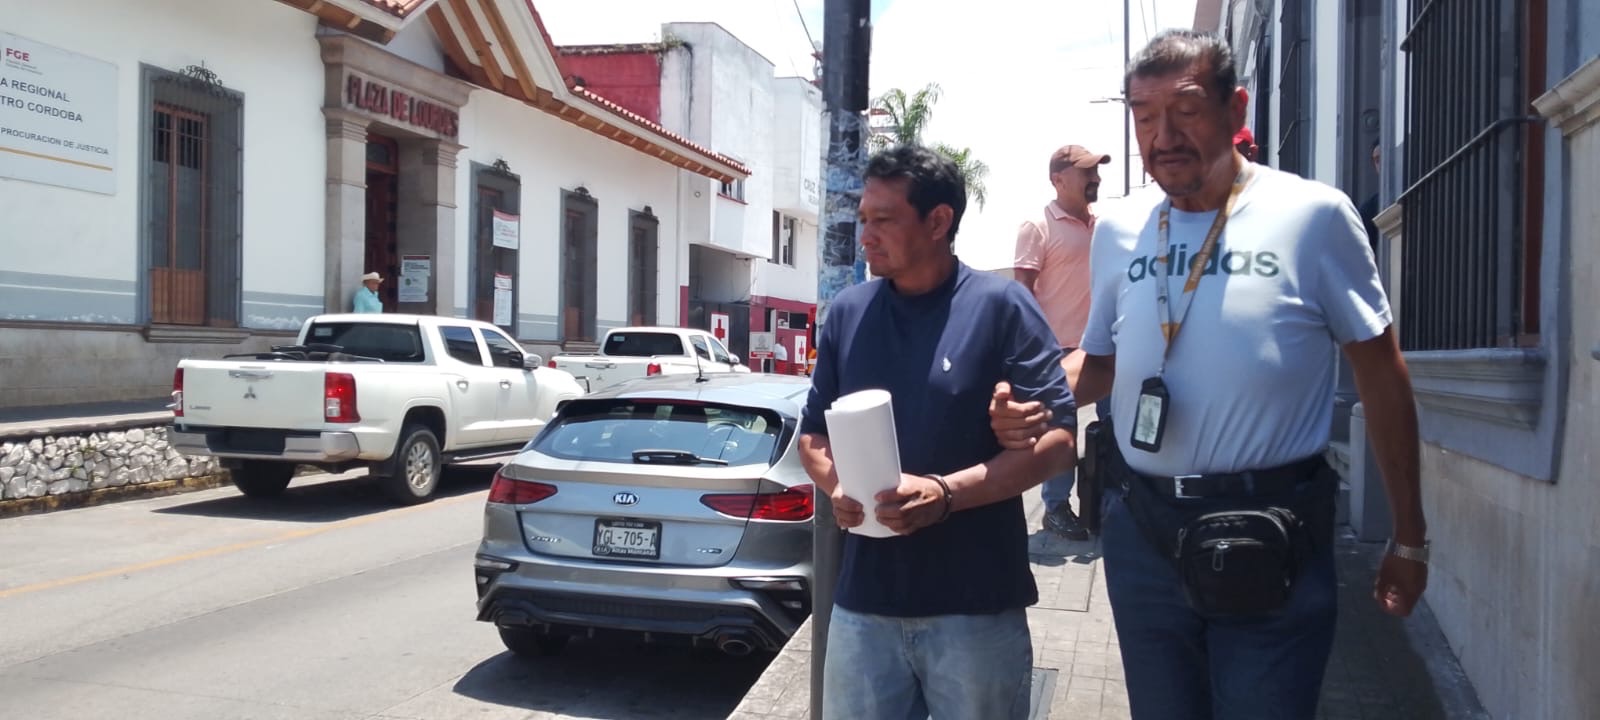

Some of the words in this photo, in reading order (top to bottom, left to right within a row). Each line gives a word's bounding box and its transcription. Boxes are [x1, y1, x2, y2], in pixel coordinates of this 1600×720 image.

[6, 48, 30, 62] FGE
[11, 80, 71, 102] REGIONAL
[347, 74, 389, 115] PLAZA
[391, 90, 409, 122] DE
[27, 101, 83, 123] CORDOBA
[1, 127, 62, 146] PROCURACION
[63, 140, 75, 149] DE
[76, 143, 109, 155] JUSTICIA
[1127, 243, 1280, 283] adidas
[615, 494, 635, 504] KIA
